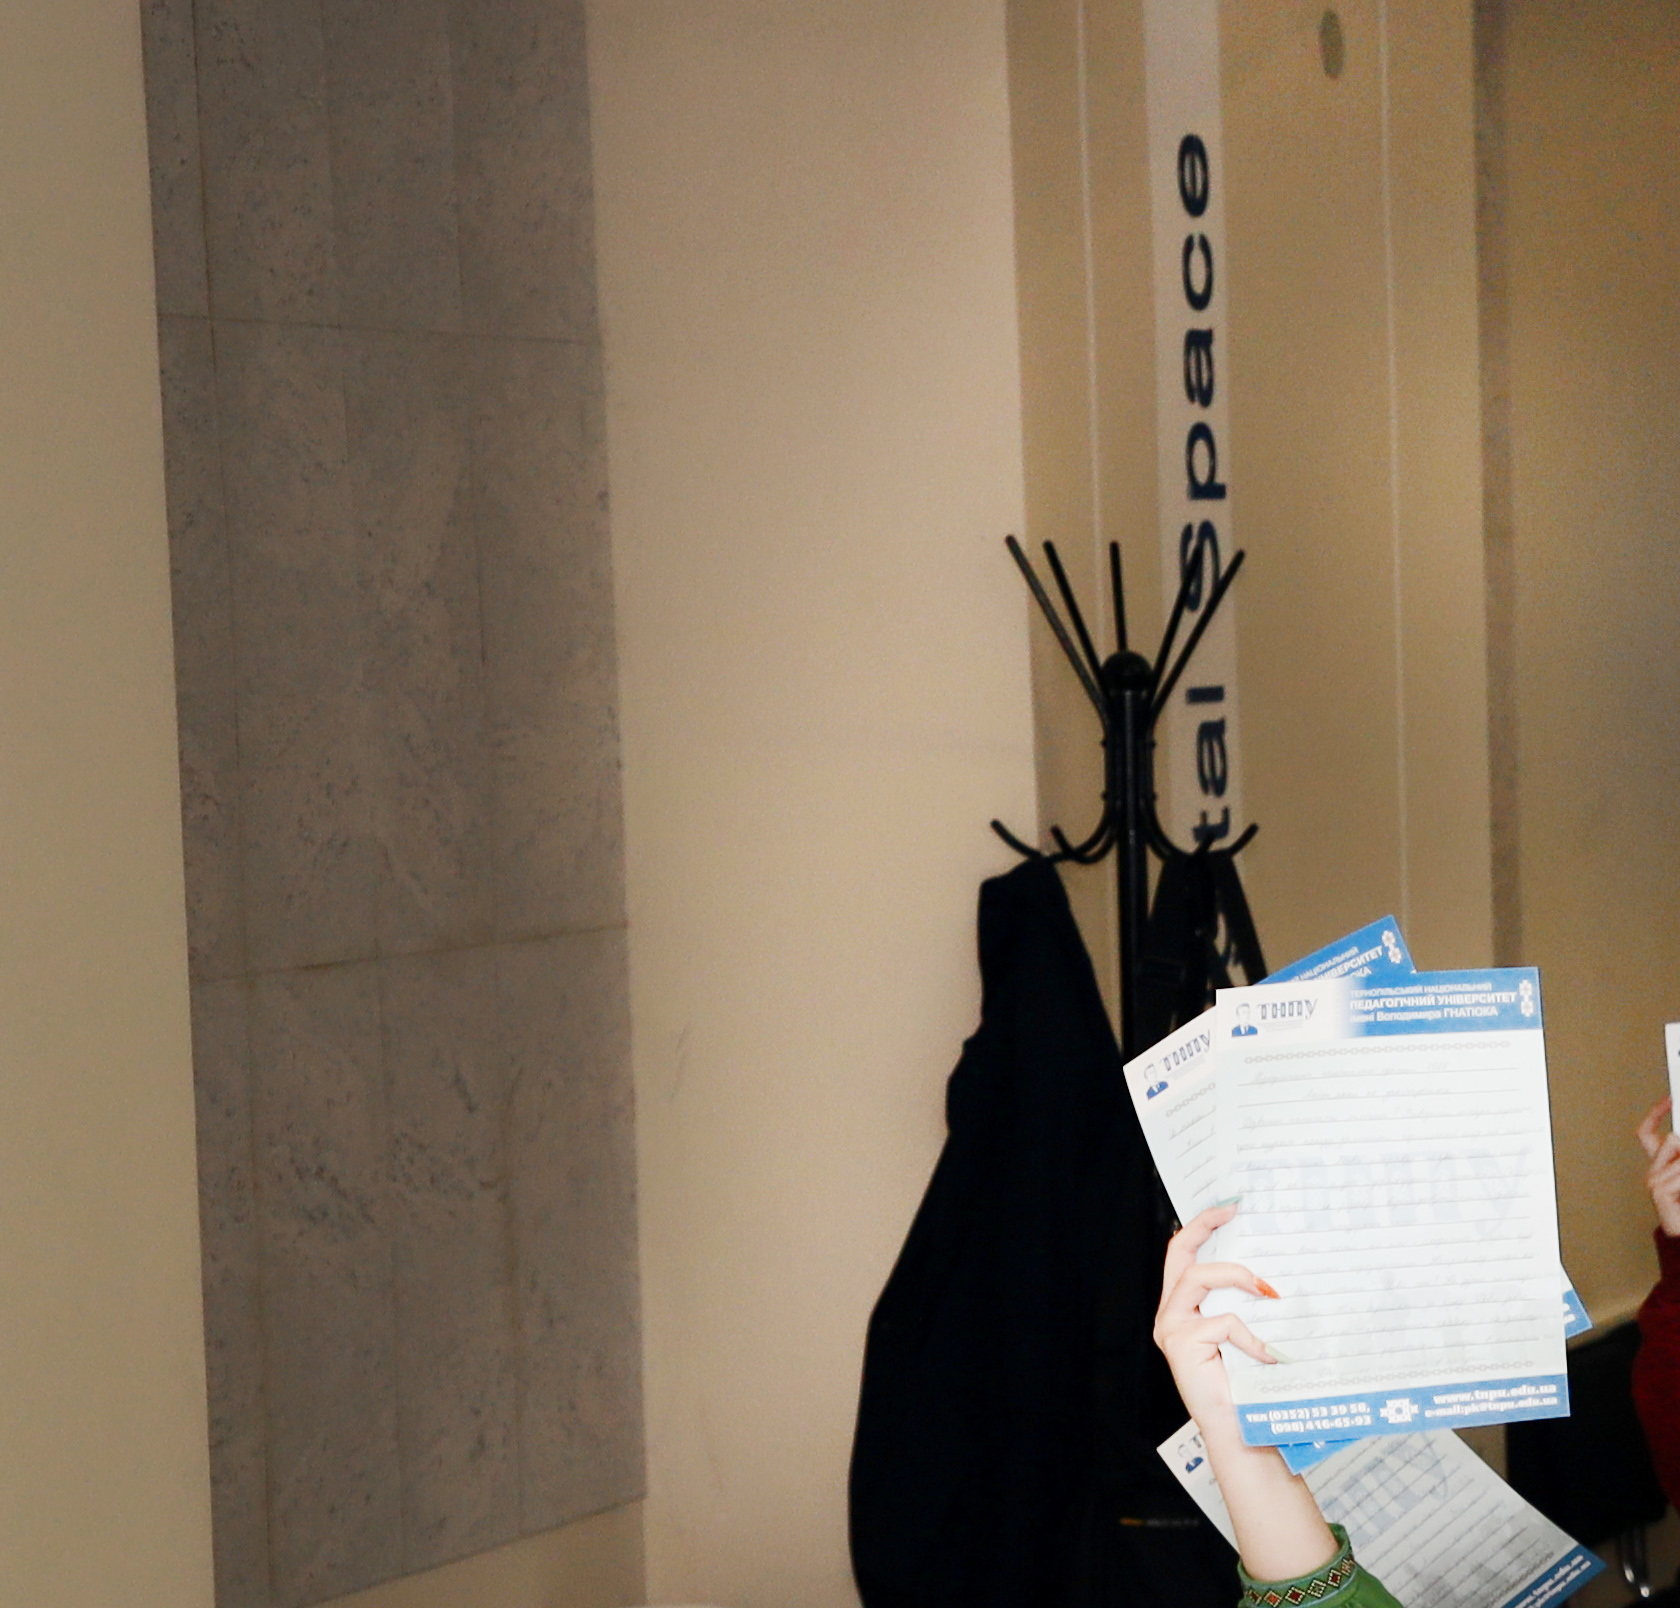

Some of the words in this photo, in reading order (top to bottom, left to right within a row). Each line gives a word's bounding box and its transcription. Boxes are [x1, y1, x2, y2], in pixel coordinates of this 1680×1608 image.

[1315, 945, 1383, 980] НІВЕРСИТЕТ
[1256, 998, 1319, 1021] ТНПУ
[1349, 995, 1436, 1011] ПЕДАГОГІЧНИЙ
[1437, 991, 1518, 1005] УНІВЕРСИТЕТ
[1443, 1004, 1499, 1018] ГНАТЮКА
[1159, 1028, 1211, 1072] ТНПУ
[1433, 1382, 1557, 1404] www.tnpu.edu.ua
[1246, 1411, 1268, 1423] тел
[1268, 1406, 1310, 1421] (0352)
[1312, 1405, 1328, 1419] 53
[1330, 1404, 1347, 1417] 39
[1349, 1402, 1371, 1416] 58,
[1270, 1421, 1304, 1435] (098)
[1306, 1415, 1372, 1431] 416-65-93
